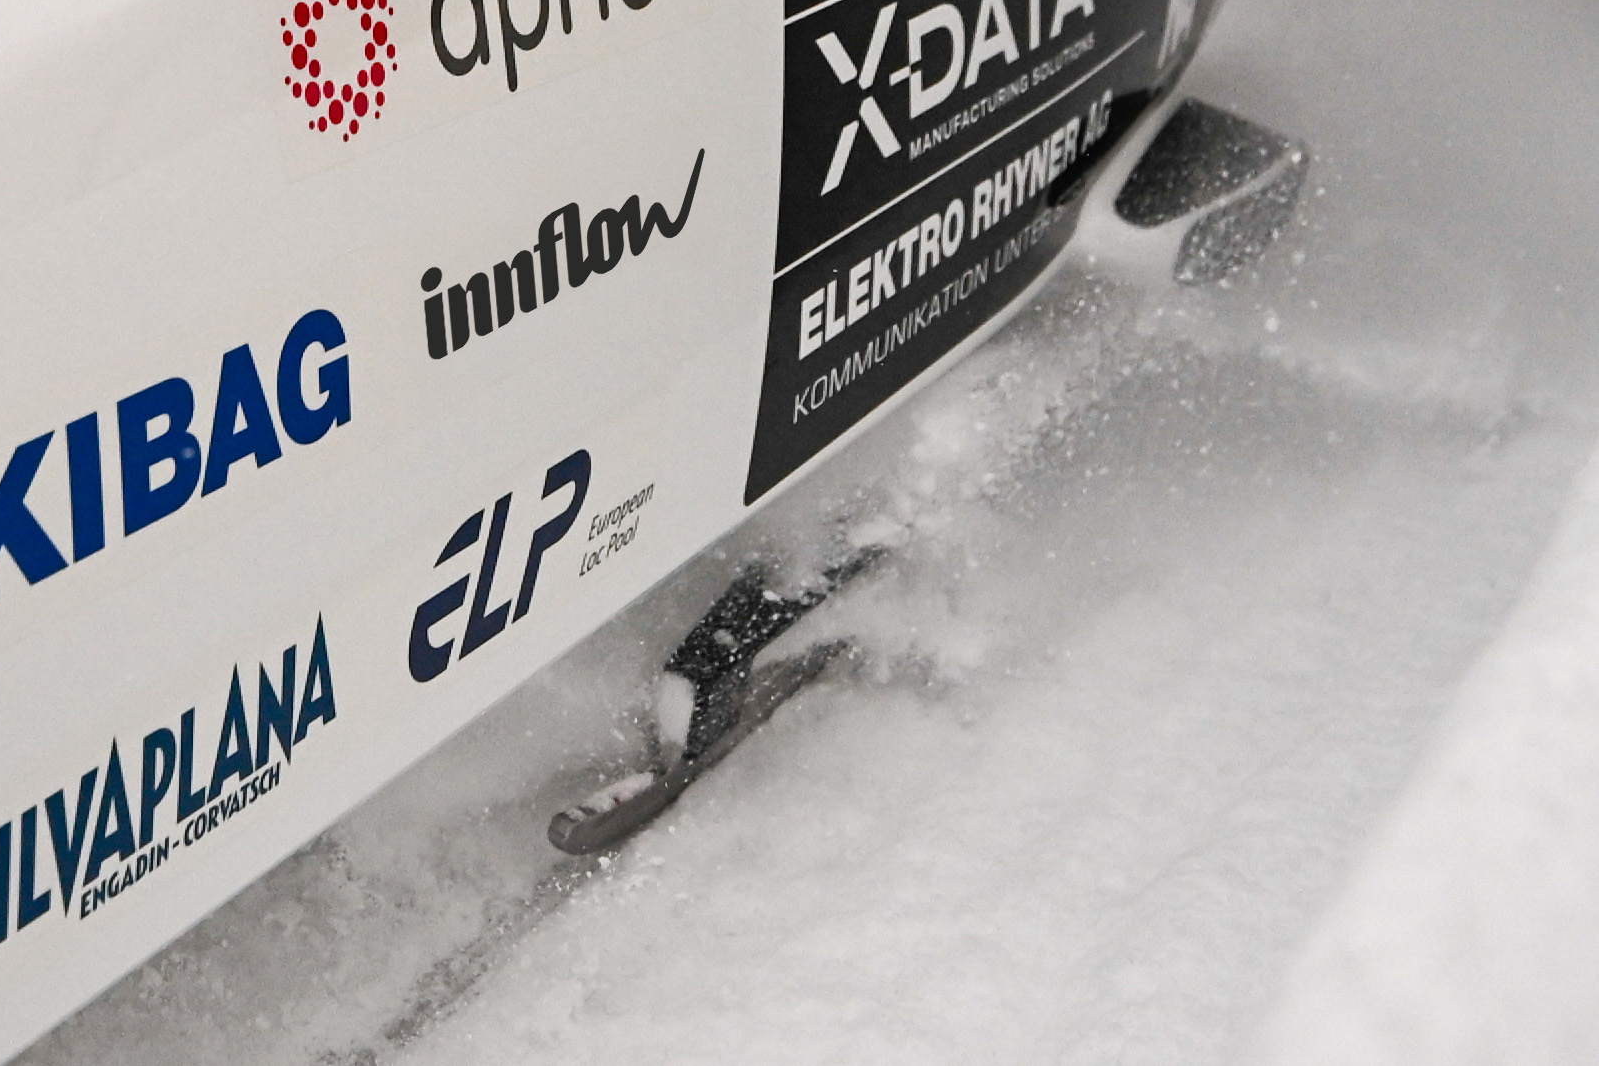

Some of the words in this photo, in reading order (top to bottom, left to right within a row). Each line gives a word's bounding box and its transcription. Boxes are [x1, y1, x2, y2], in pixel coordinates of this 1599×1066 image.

[908, 73, 1030, 162] MANUFACTURING
[1031, 32, 1096, 87] SOLUTIONS
[420, 147, 705, 360] innflow
[798, 198, 966, 361] ELEKTRO
[970, 115, 1081, 241] RHYNER
[1080, 88, 1113, 154] AG
[792, 255, 990, 424] KOMMUNIKATION
[408, 448, 592, 683] ELP
[578, 544, 605, 577] Loc
[605, 516, 640, 560] Pool
[587, 482, 655, 542] European
